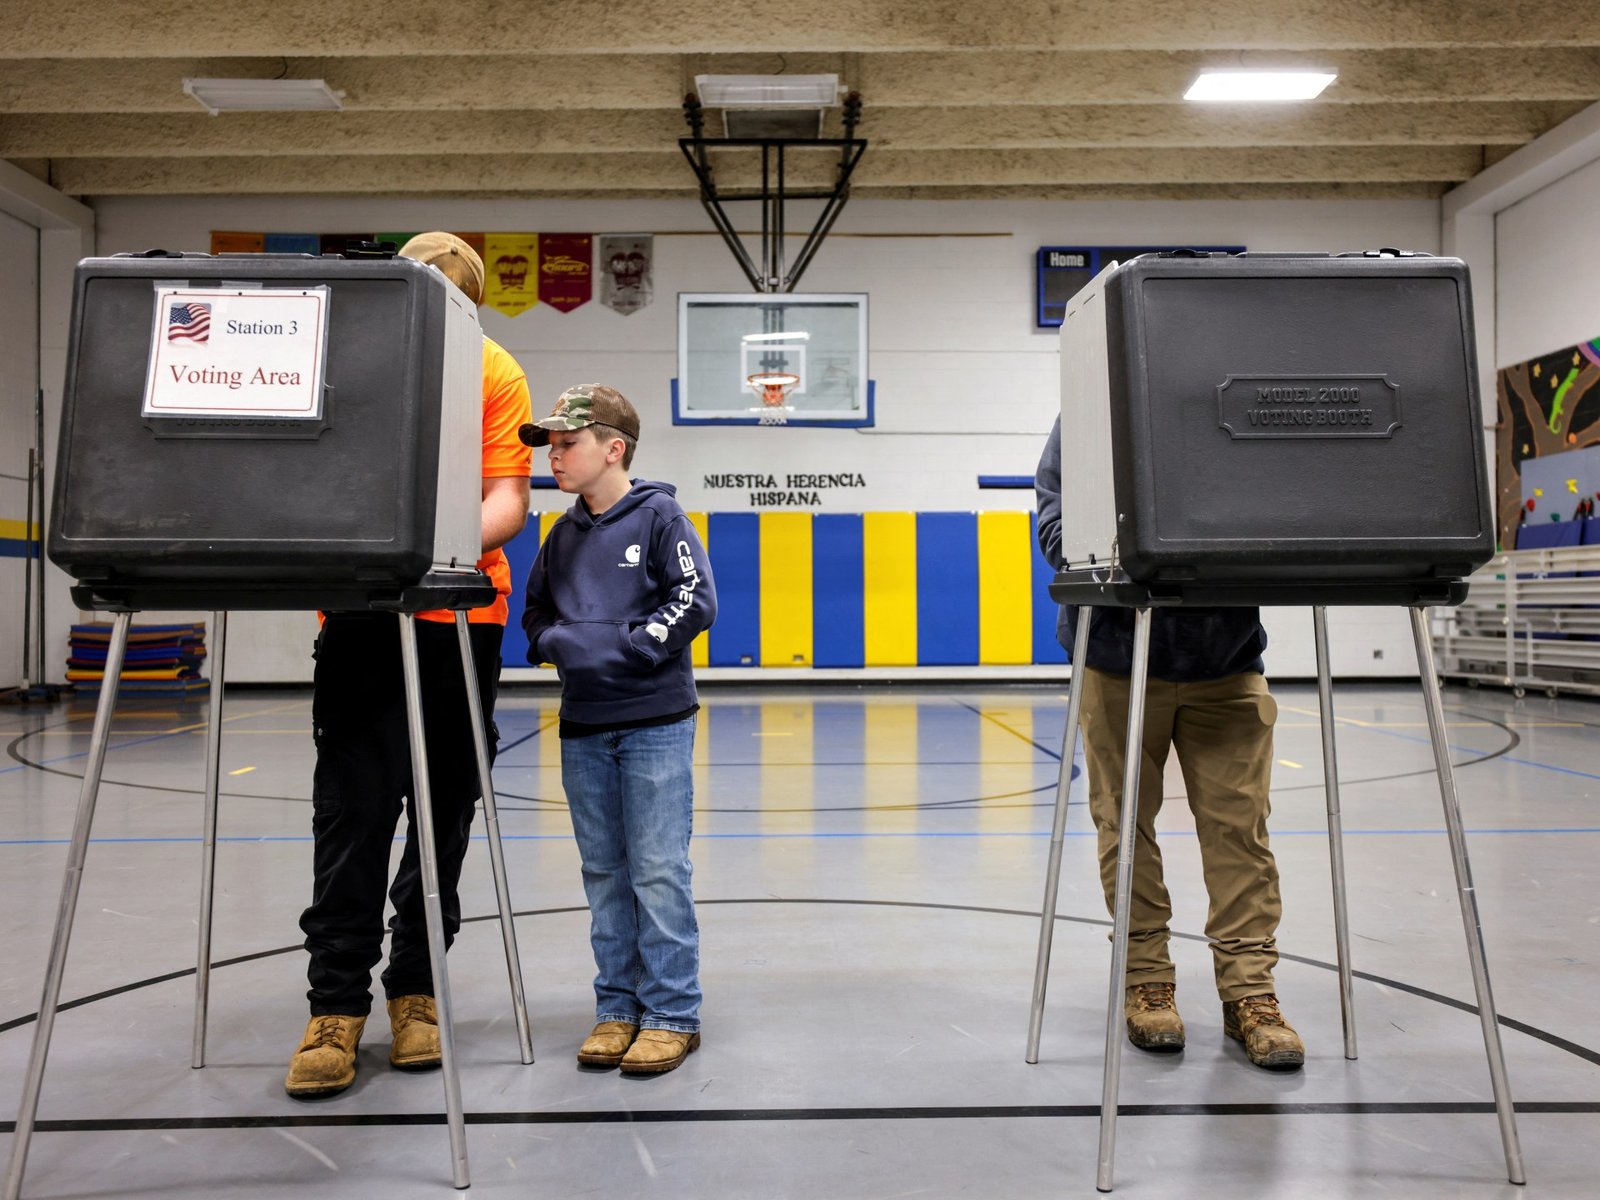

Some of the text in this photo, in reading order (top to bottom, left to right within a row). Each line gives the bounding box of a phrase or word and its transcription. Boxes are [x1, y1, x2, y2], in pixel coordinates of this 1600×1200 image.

[1050, 252, 1084, 267] Home
[226, 319, 298, 335] Station 3
[169, 365, 302, 390] Voting Area
[1256, 387, 1361, 404] MODEL 2000
[1247, 409, 1373, 426] VOTING BOOTH
[704, 473, 866, 489] NUESTRA HERENCIA
[750, 491, 822, 506] HISPANA
